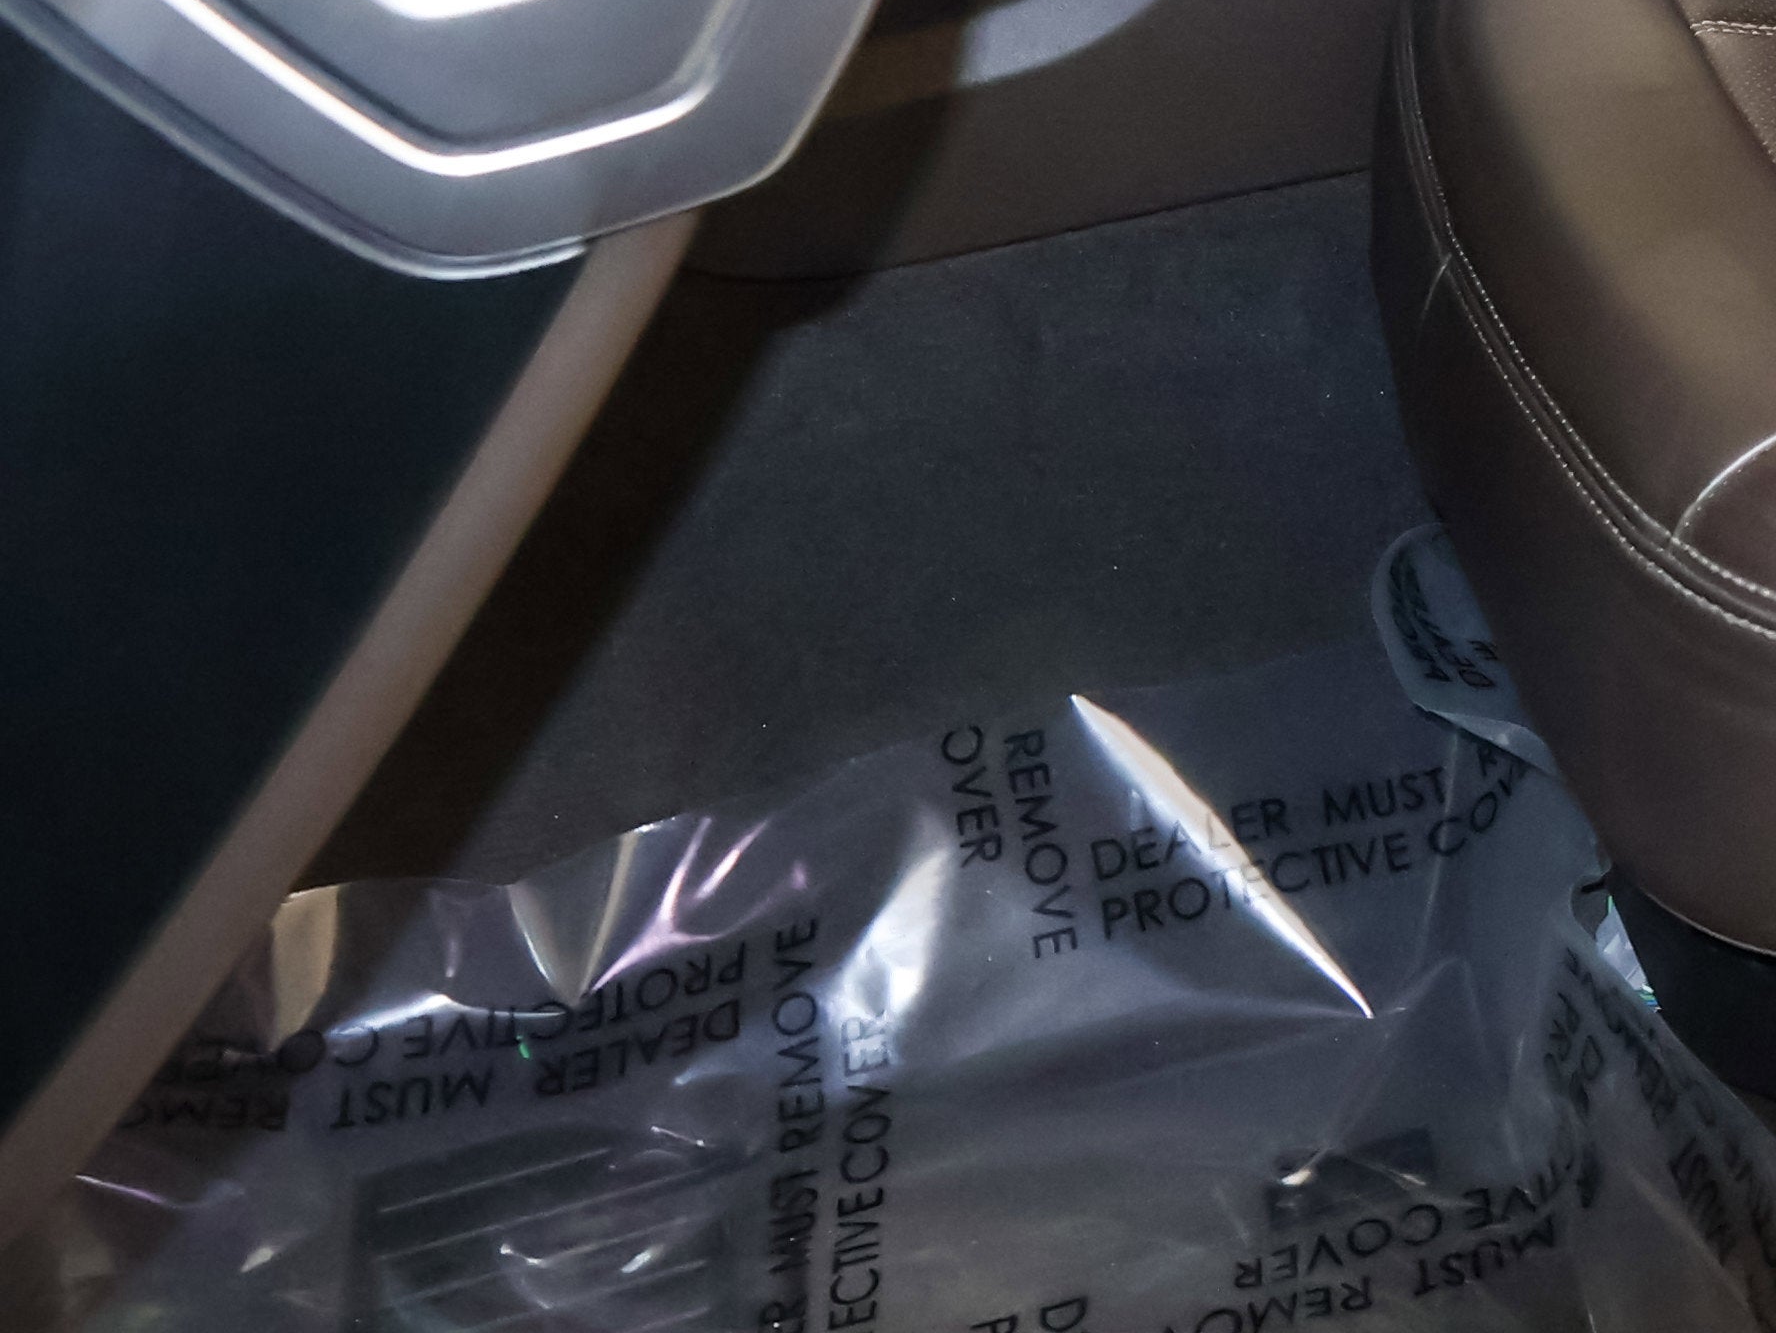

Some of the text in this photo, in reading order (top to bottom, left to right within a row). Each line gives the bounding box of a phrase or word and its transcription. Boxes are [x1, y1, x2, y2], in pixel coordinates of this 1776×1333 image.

[1003, 728, 1077, 960] REMOVE
[1091, 764, 1448, 882] DEALER MUST
[533, 997, 741, 1099] DEALER
[772, 916, 826, 1155] REMOVE
[329, 1065, 495, 1131] MUST
[1234, 1203, 1443, 1290] COVER
[1412, 1213, 1556, 1298] MUST
